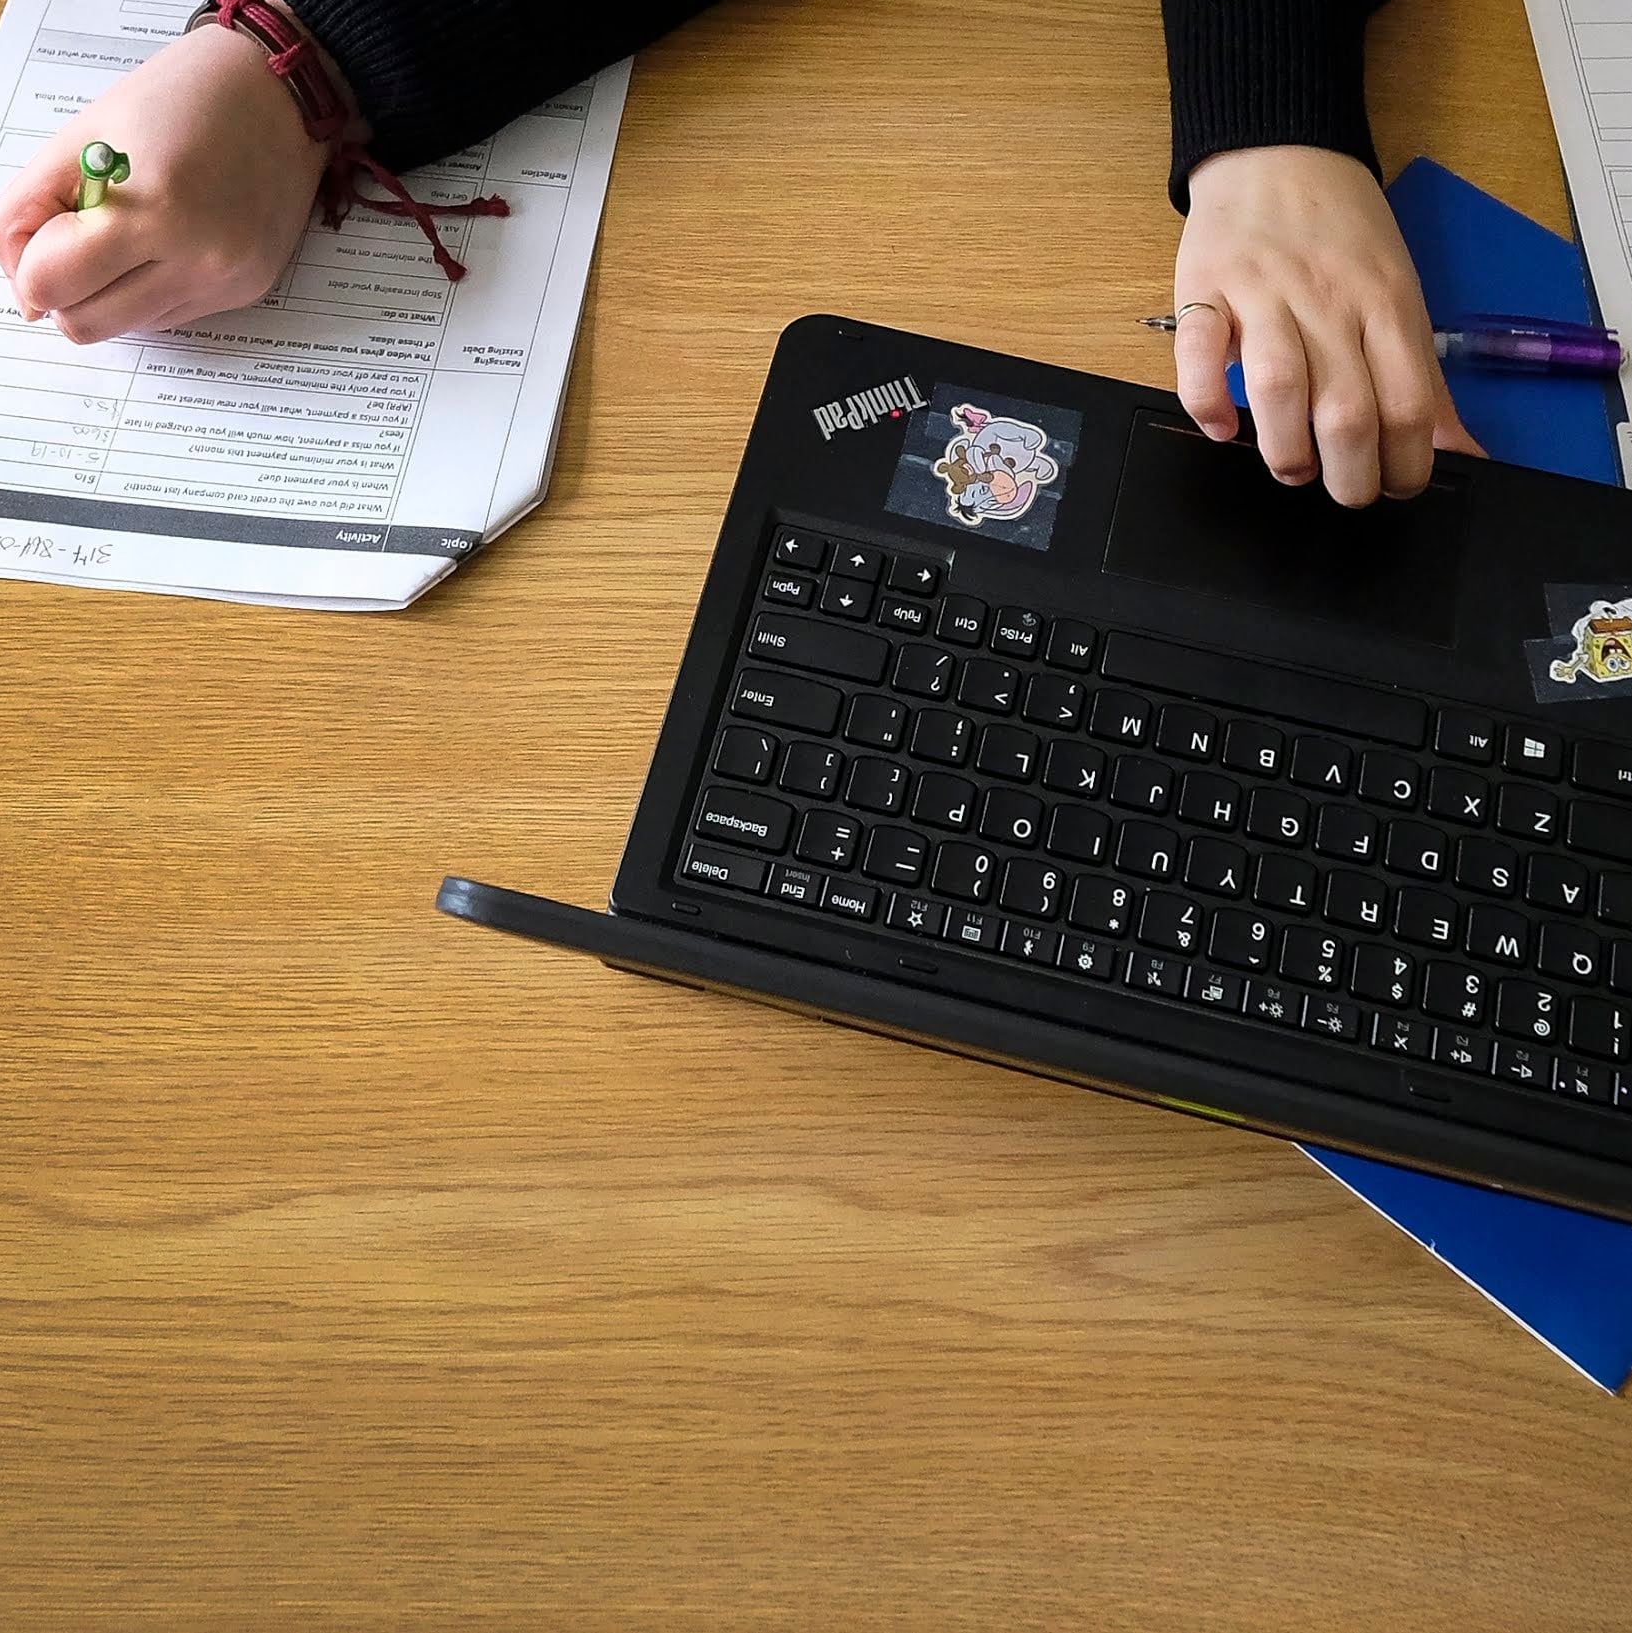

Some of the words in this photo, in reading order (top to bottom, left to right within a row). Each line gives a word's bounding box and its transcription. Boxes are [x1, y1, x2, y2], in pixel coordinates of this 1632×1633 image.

[461, 345, 486, 356] Debt
[486, 345, 526, 358] Existing
[472, 355, 523, 368] Managing
[813, 376, 927, 440] ThinkPad
[123, 417, 142, 428] late
[142, 419, 153, 429] in
[153, 419, 194, 433] charged
[193, 424, 207, 435] be
[208, 424, 227, 435] you
[226, 427, 245, 438] will
[245, 429, 273, 441] much
[272, 432, 295, 443] how
[377, 429, 404, 440] fees?
[296, 432, 342, 448] payment,
[350, 439, 373, 451] miss
[372, 440, 392, 450] you
[187, 443, 226, 456] month?
[226, 447, 244, 457] this
[245, 447, 288, 461] payment
[391, 443, 401, 453] If
[288, 452, 335, 465] minimum
[335, 454, 359, 465] your
[358, 458, 368, 468] is
[368, 459, 395, 471] What
[256, 473, 282, 484] due?
[282, 473, 326, 487] payment
[326, 476, 350, 486] your
[350, 479, 359, 489] is
[360, 480, 389, 491] When
[122, 482, 162, 494] month?
[162, 485, 181, 496] last
[181, 485, 226, 497] company
[226, 490, 248, 501] card
[249, 492, 277, 504] credit
[277, 494, 295, 505] the
[296, 496, 318, 505] owe
[318, 496, 338, 507] you
[338, 499, 356, 510] did
[356, 501, 383, 512] What
[334, 529, 383, 542] Activity
[773, 581, 800, 595] PgDn
[894, 608, 921, 622] PgUp
[955, 617, 977, 630] Ctrl
[758, 632, 786, 647] Shift
[1001, 624, 1034, 643] PrtSc
[1071, 644, 1088, 656] Alt
[741, 690, 774, 706] Enter
[1122, 717, 1141, 736] M
[1191, 733, 1208, 752] N
[1470, 735, 1488, 747] Alt
[1017, 754, 1029, 772] L
[1260, 749, 1275, 767] B
[1079, 769, 1095, 789] K
[1326, 765, 1341, 783] V
[1150, 786, 1162, 802] J
[1394, 781, 1411, 798] C
[949, 804, 965, 822] P
[1214, 801, 1231, 821] H
[1464, 796, 1480, 816] X
[706, 813, 767, 836] Backspace
[1282, 817, 1298, 836] G
[1534, 813, 1551, 832] Z
[1353, 836, 1368, 853] F
[1152, 852, 1168, 871] U
[1421, 851, 1438, 870] D
[692, 861, 728, 880] Delete
[1492, 868, 1509, 887] S
[1043, 872, 1056, 889] 9
[1220, 869, 1235, 889] Y
[781, 883, 805, 898] End
[1113, 889, 1126, 906] 8
[1290, 886, 1306, 905] T
[1563, 884, 1579, 903] A
[832, 895, 866, 914] Home
[1361, 901, 1378, 922] R
[1181, 907, 1193, 924] 7
[1252, 923, 1265, 940] 6
[1432, 919, 1449, 939] E
[1322, 940, 1335, 958] 5
[1496, 935, 1519, 957] W
[1394, 958, 1407, 975] 4
[1573, 952, 1592, 974] Q
[1466, 975, 1479, 993] 3
[1538, 993, 1552, 1011] 2
[1614, 1011, 1622, 1029] 1
